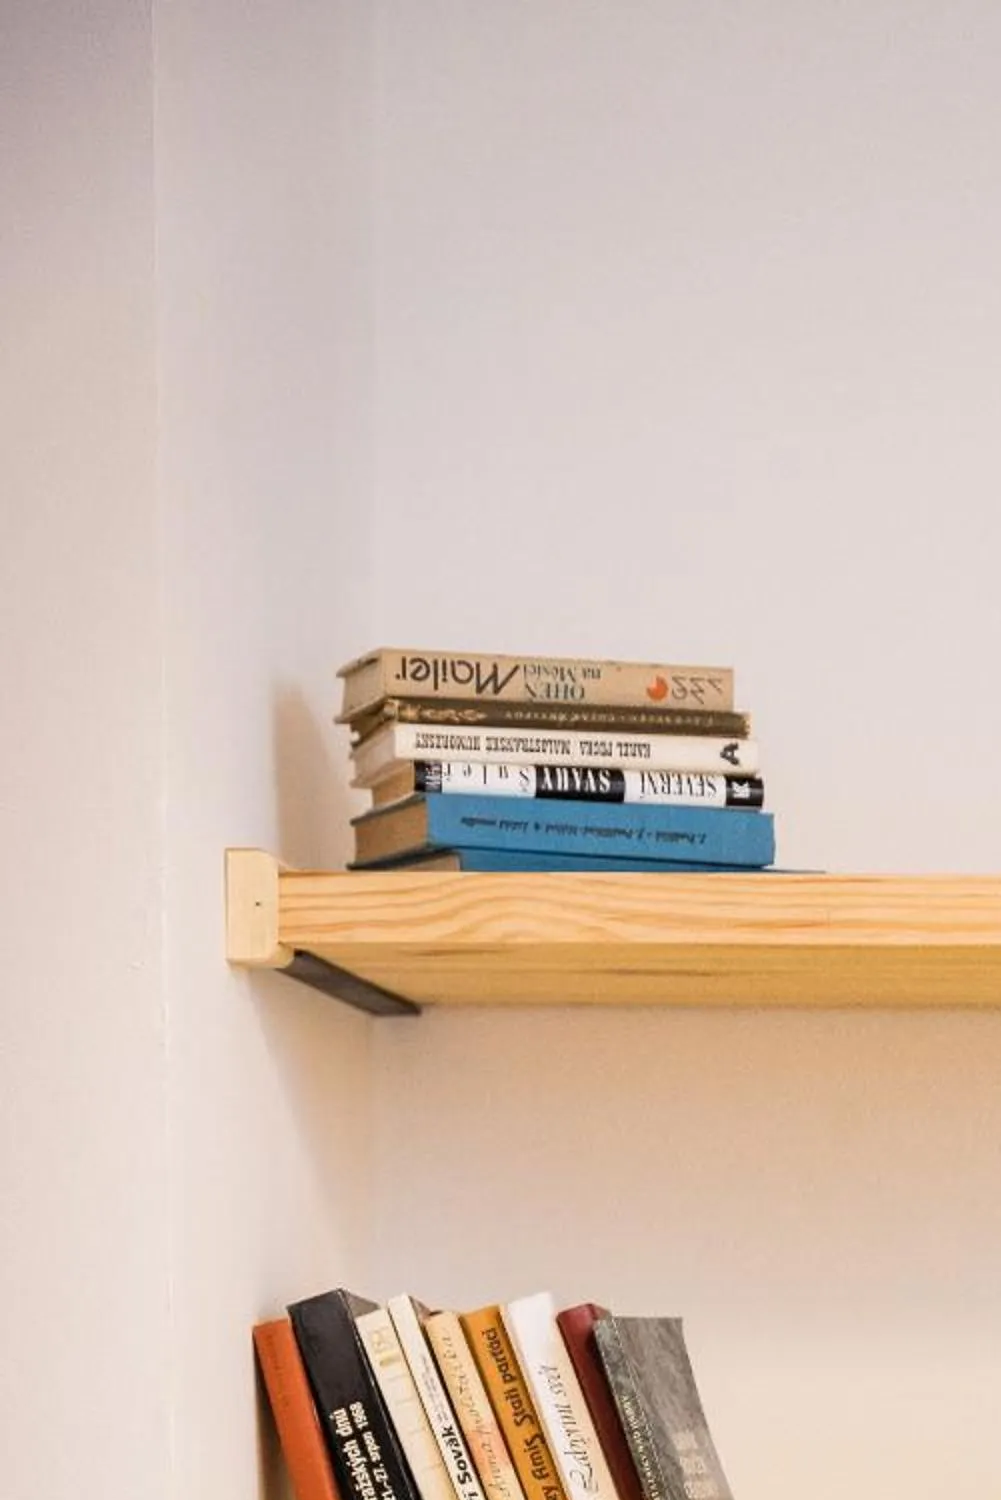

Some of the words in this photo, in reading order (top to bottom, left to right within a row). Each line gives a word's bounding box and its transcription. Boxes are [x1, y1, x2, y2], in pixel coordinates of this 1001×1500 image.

[395, 656, 520, 695] Mailer
[582, 667, 602, 679] na
[617, 742, 651, 759] KAREL
[542, 766, 612, 793] SVAHY
[640, 771, 717, 799] SEVERNÍ
[329, 1406, 353, 1436] dnů
[348, 1400, 369, 1429] 1968
[362, 1430, 383, 1462] srpen
[439, 1424, 473, 1485] Sovák
[529, 1432, 549, 1482] Amis
